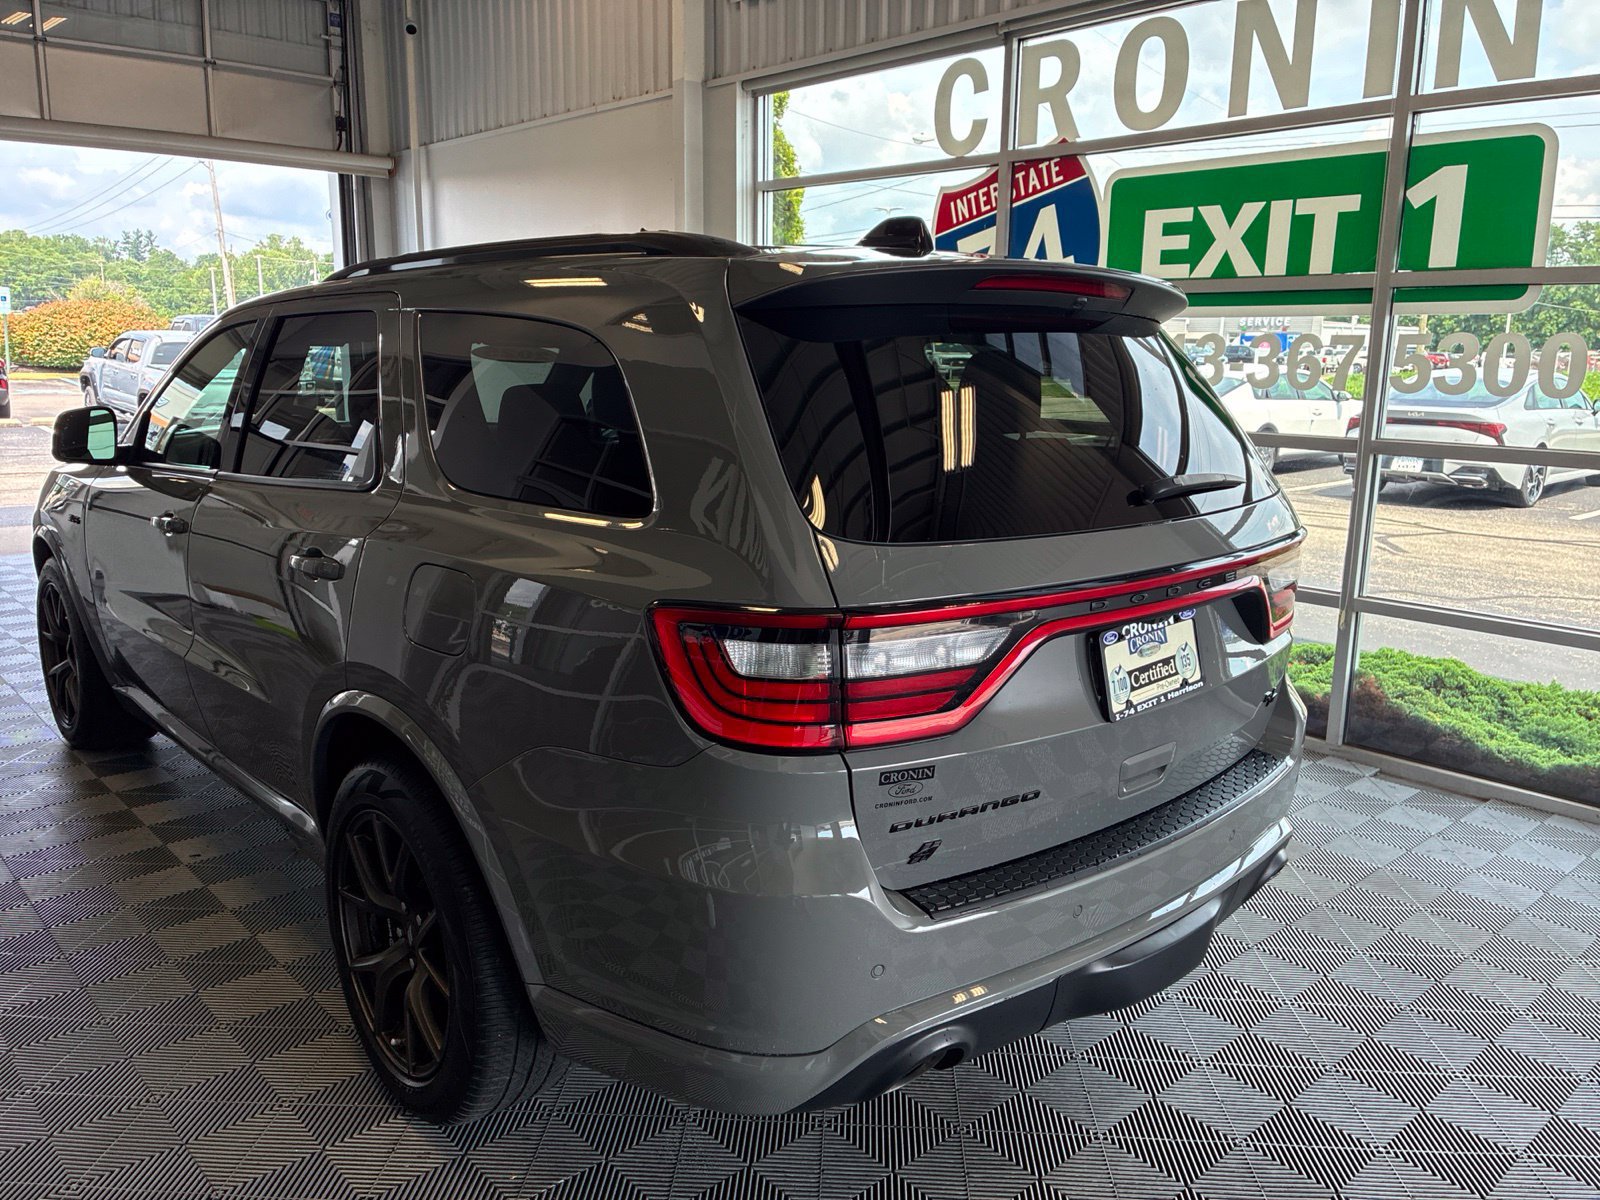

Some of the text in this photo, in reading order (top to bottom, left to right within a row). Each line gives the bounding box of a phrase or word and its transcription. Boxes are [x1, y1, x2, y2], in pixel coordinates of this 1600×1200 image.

[934, 0, 1542, 157] CRONIN
[950, 158, 1064, 224] INTERTATE
[1141, 164, 1468, 278] EXIT 1
[1239, 316, 1291, 327] SERVICE
[1090, 571, 1236, 611] DODGE
[1130, 629, 1166, 653] CRONIN
[1131, 659, 1177, 687] Certified
[1115, 681, 1204, 721] I-74 EXIT 1 Harrison
[880, 766, 936, 785] CRONIN
[874, 796, 933, 809] CRONINFORD.COM
[889, 789, 1041, 834] DURANGO
